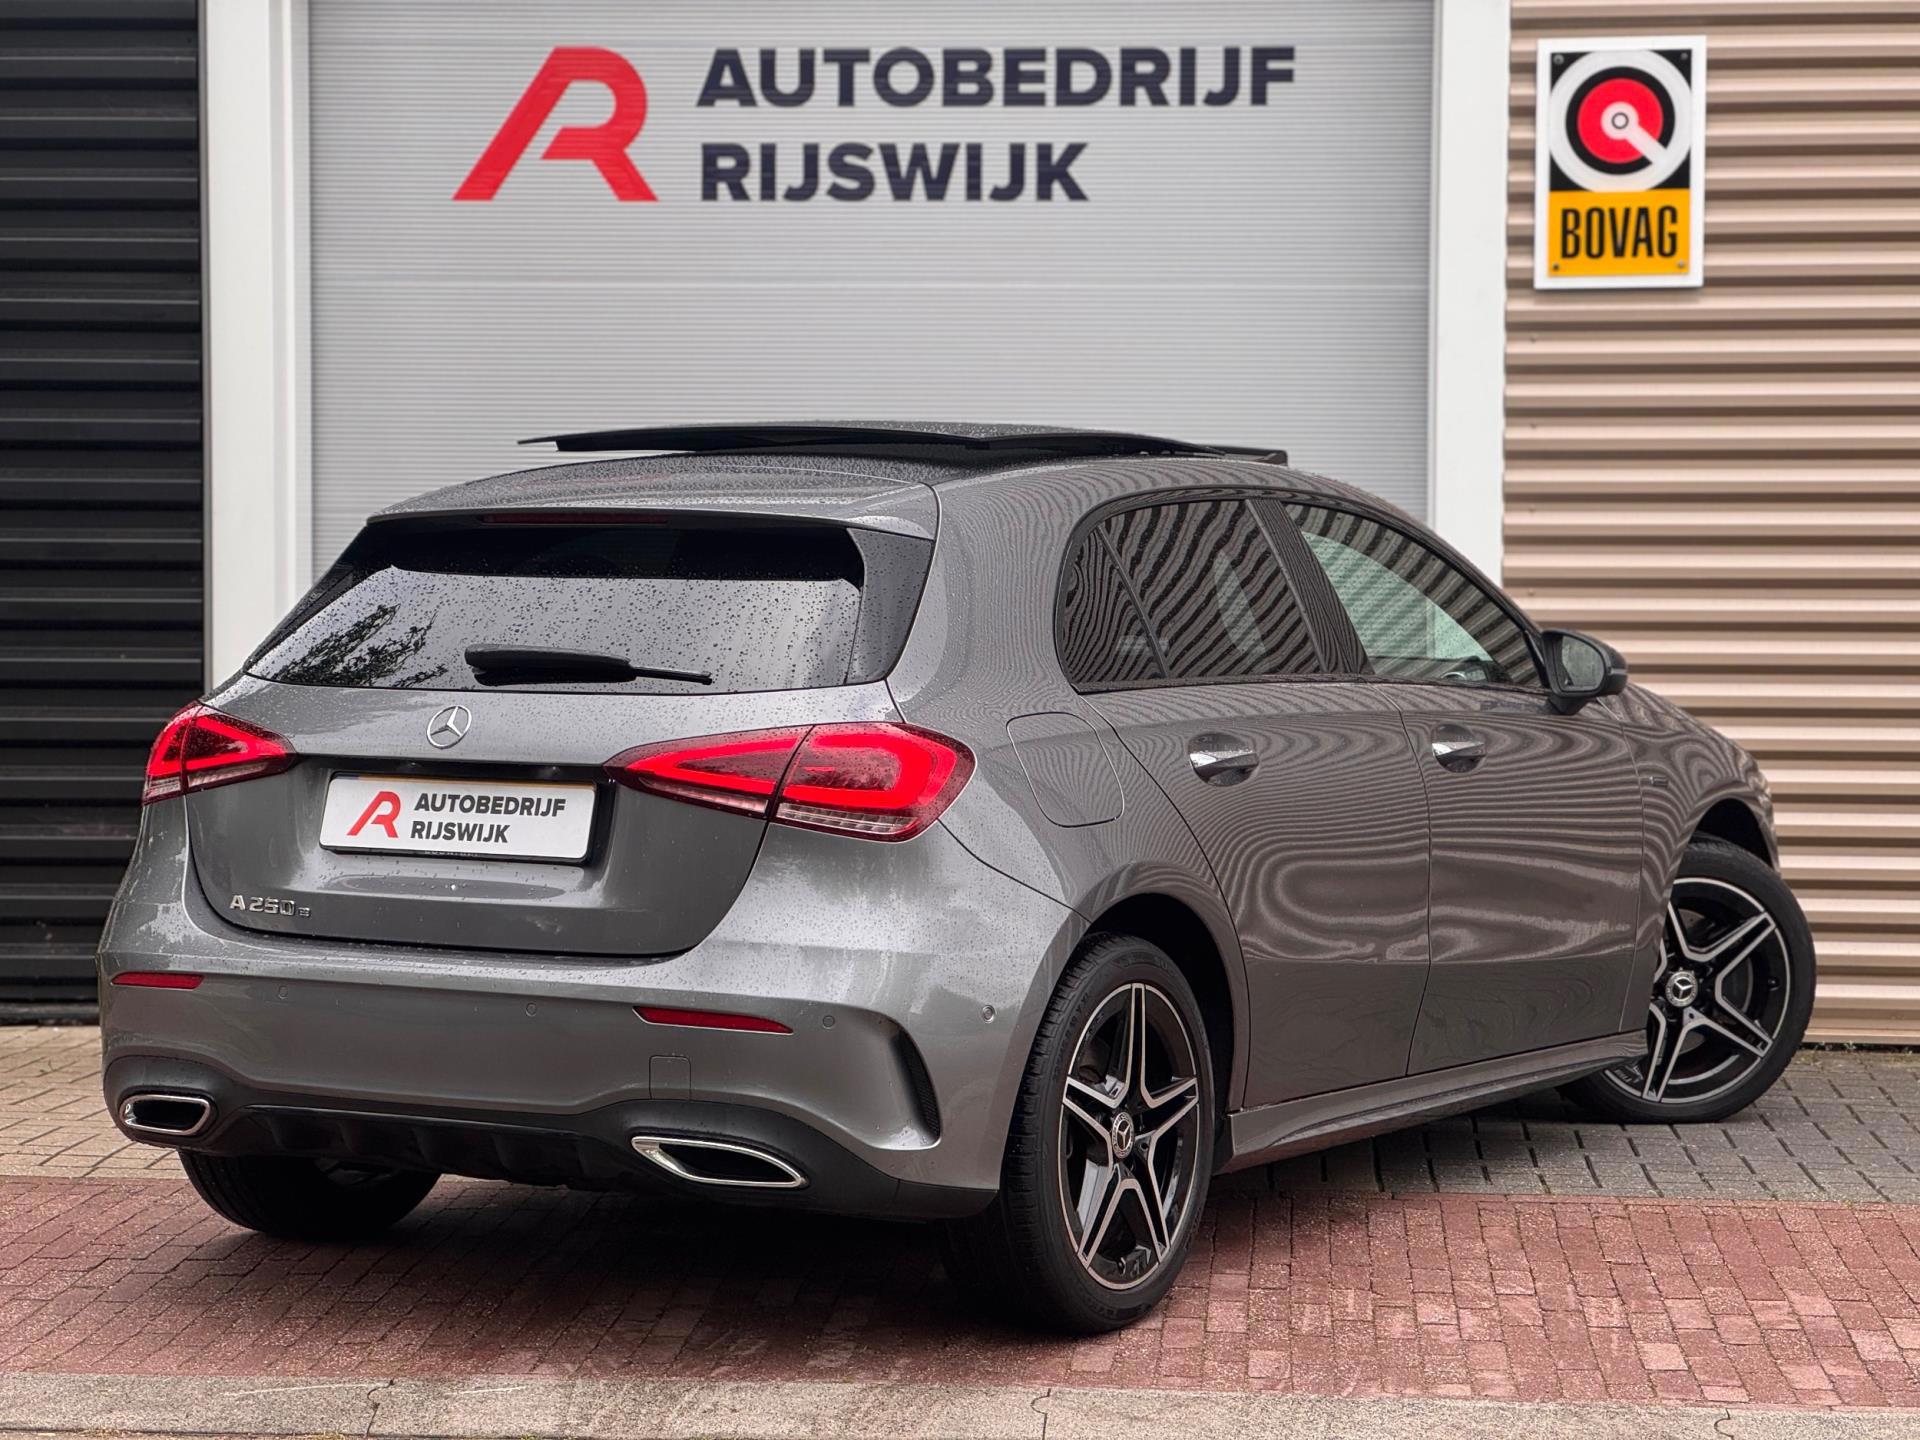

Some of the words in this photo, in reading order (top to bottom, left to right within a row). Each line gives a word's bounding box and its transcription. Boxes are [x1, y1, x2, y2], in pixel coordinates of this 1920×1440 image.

[697, 46, 1295, 107] AUTOBEDRIJF
[702, 143, 1087, 201] RIJSWIJK
[1561, 205, 1678, 259] BOVAG
[414, 793, 567, 817] AUTOBEDRIJF
[410, 820, 510, 843] RIJSWIJK
[229, 894, 246, 911] A
[248, 896, 295, 916] 250
